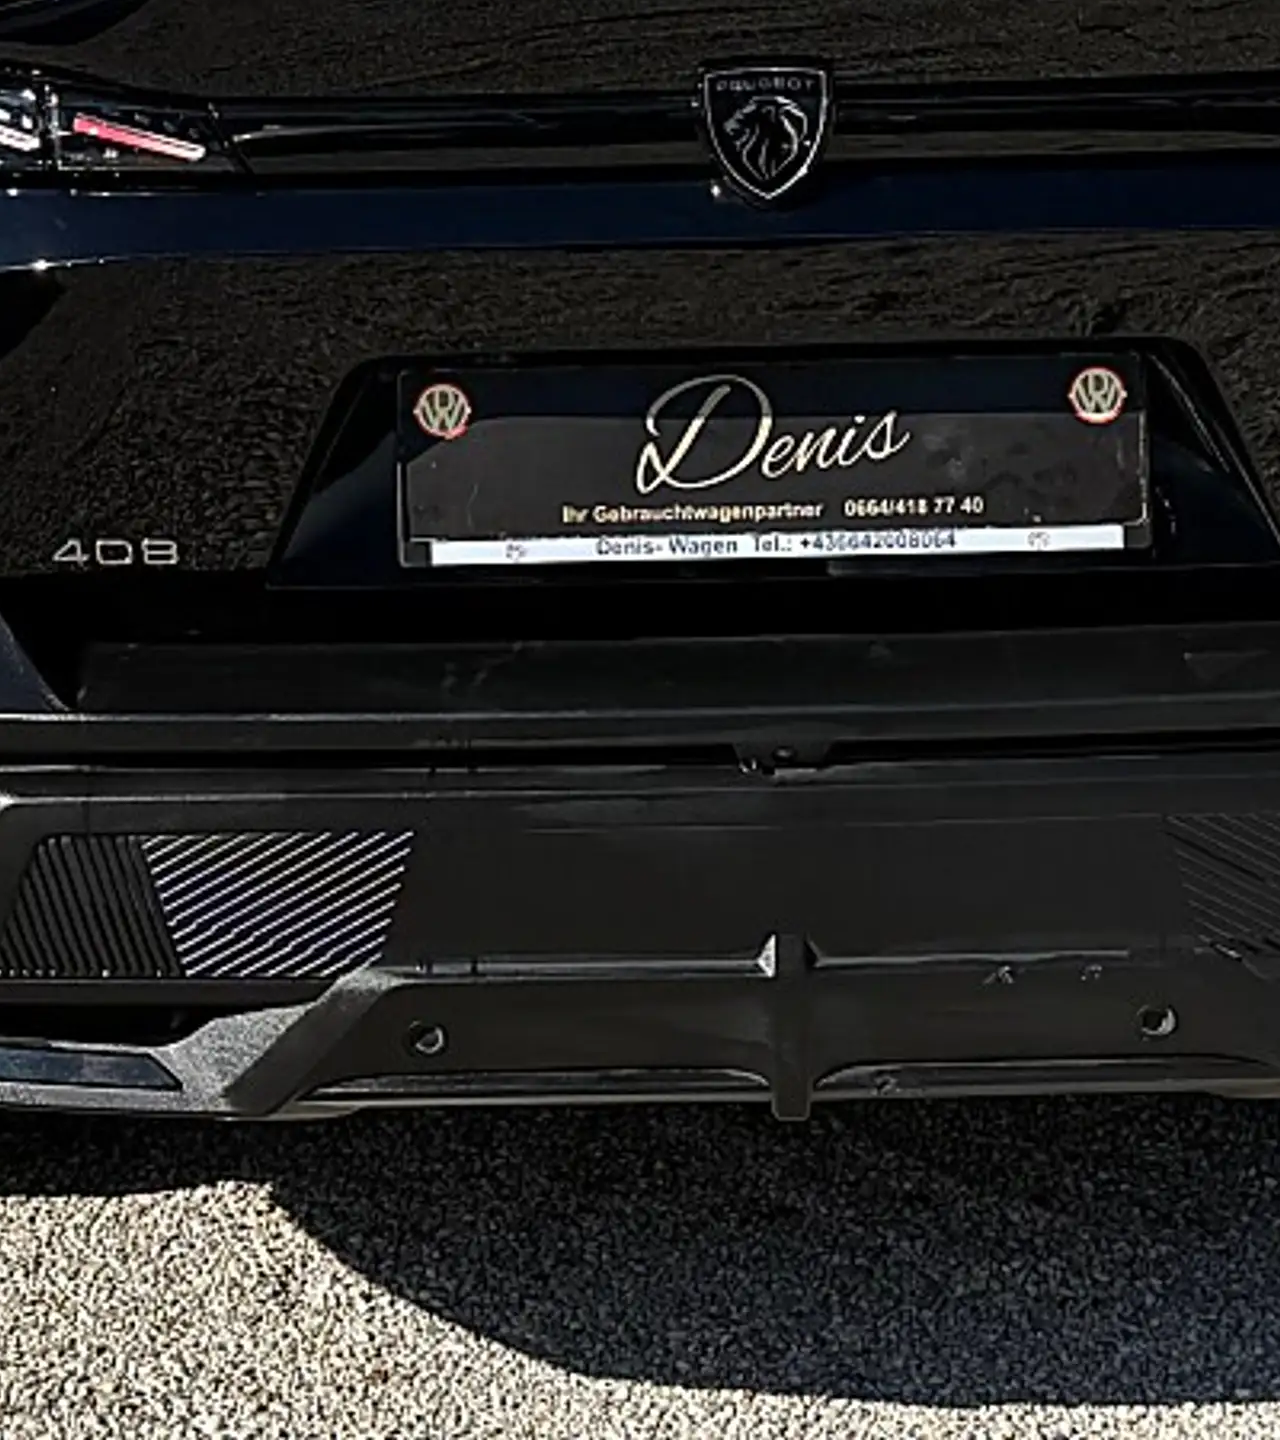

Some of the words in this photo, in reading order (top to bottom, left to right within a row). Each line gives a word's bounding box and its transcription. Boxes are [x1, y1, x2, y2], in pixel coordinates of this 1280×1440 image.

[636, 373, 911, 495] Denis
[561, 504, 589, 523] Ihr
[592, 499, 825, 525] Gebrauchtwagenpartner
[844, 498, 929, 517] 0664/418
[933, 496, 956, 514] 77
[959, 495, 985, 514] 40
[52, 537, 181, 566] 408
[669, 533, 739, 557] Wagen
